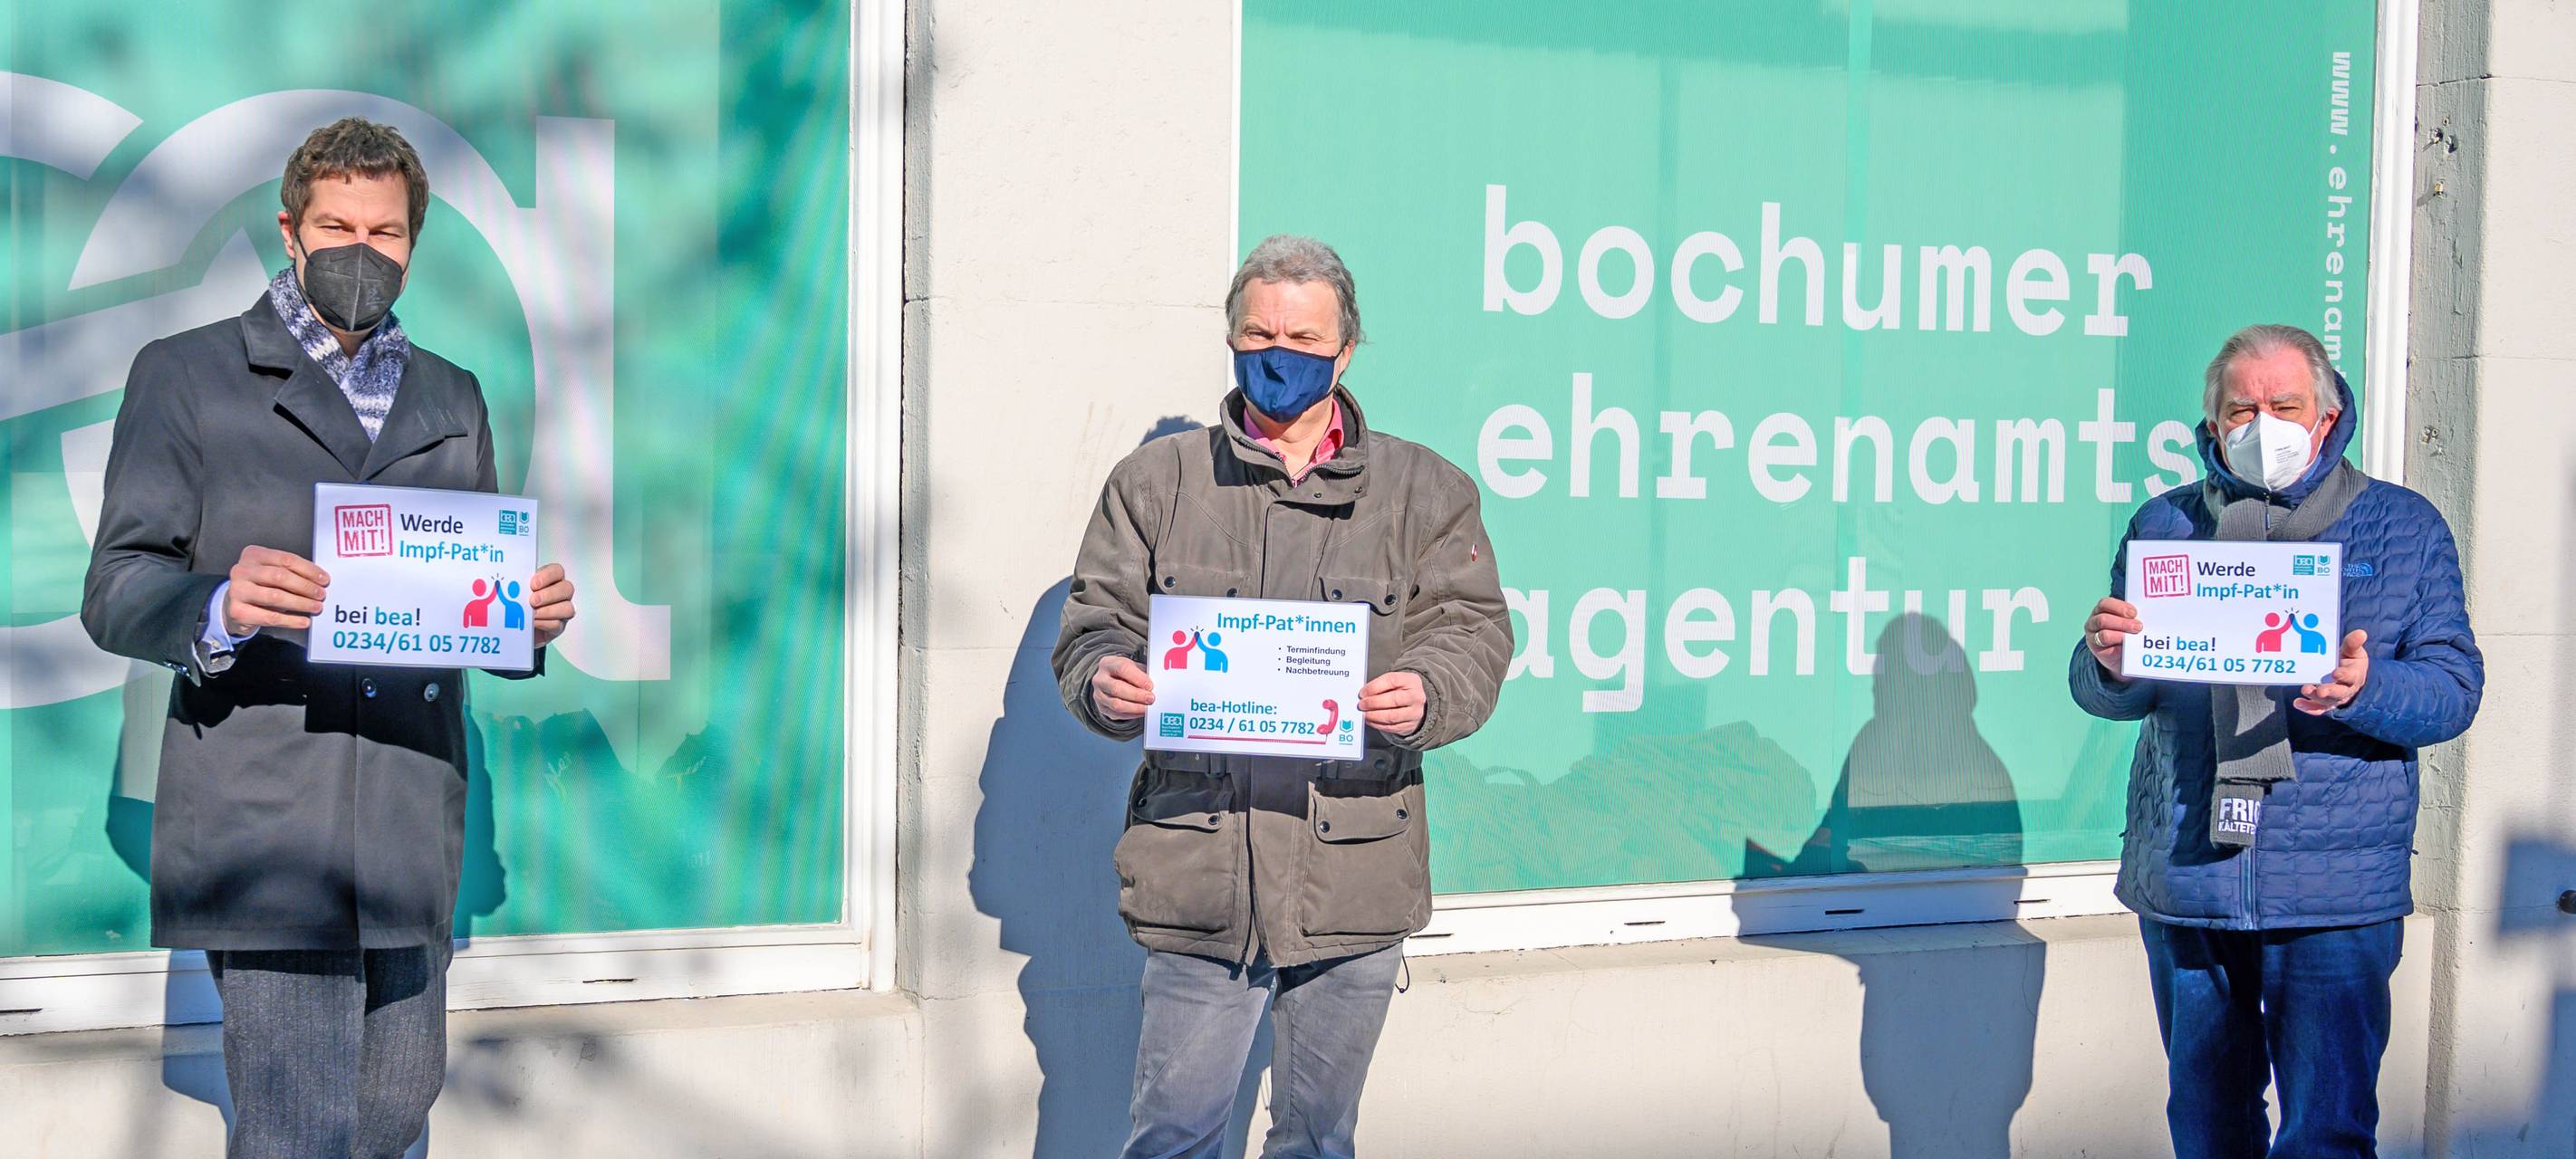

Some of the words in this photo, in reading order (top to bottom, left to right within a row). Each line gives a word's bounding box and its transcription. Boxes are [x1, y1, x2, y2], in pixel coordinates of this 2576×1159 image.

[2324, 52, 2352, 377] www.ehrenam
[1483, 184, 2153, 337] bochumer
[1477, 372, 2196, 504] ehrenamts
[342, 510, 384, 528] MACH
[400, 513, 464, 534] Werde
[344, 530, 385, 551] MIT!
[2148, 560, 2183, 575] MACH
[2197, 561, 2255, 577] Werde
[2150, 575, 2185, 593] MIT!
[335, 605, 368, 624] bei
[375, 607, 420, 626] bea!
[332, 630, 422, 654] 0234/61
[429, 636, 453, 653] 05
[458, 636, 501, 654] 7782
[1501, 556, 2050, 713] agentur
[2143, 635, 2170, 650] bei
[2177, 637, 2216, 652] bea!
[1286, 646, 1346, 656] Terminfindung
[1286, 656, 1331, 666] Begleitung
[2142, 654, 2217, 673] 0234/61
[2224, 658, 2245, 672] 05
[2252, 658, 2296, 674] 7782
[1285, 666, 1350, 677] Nachbetreuung
[1190, 698, 1277, 715] bea-Hotline:
[1189, 717, 1224, 731] 0234
[1238, 718, 1255, 732] 61
[1260, 720, 1277, 733] 05
[1281, 721, 1315, 734] 7782
